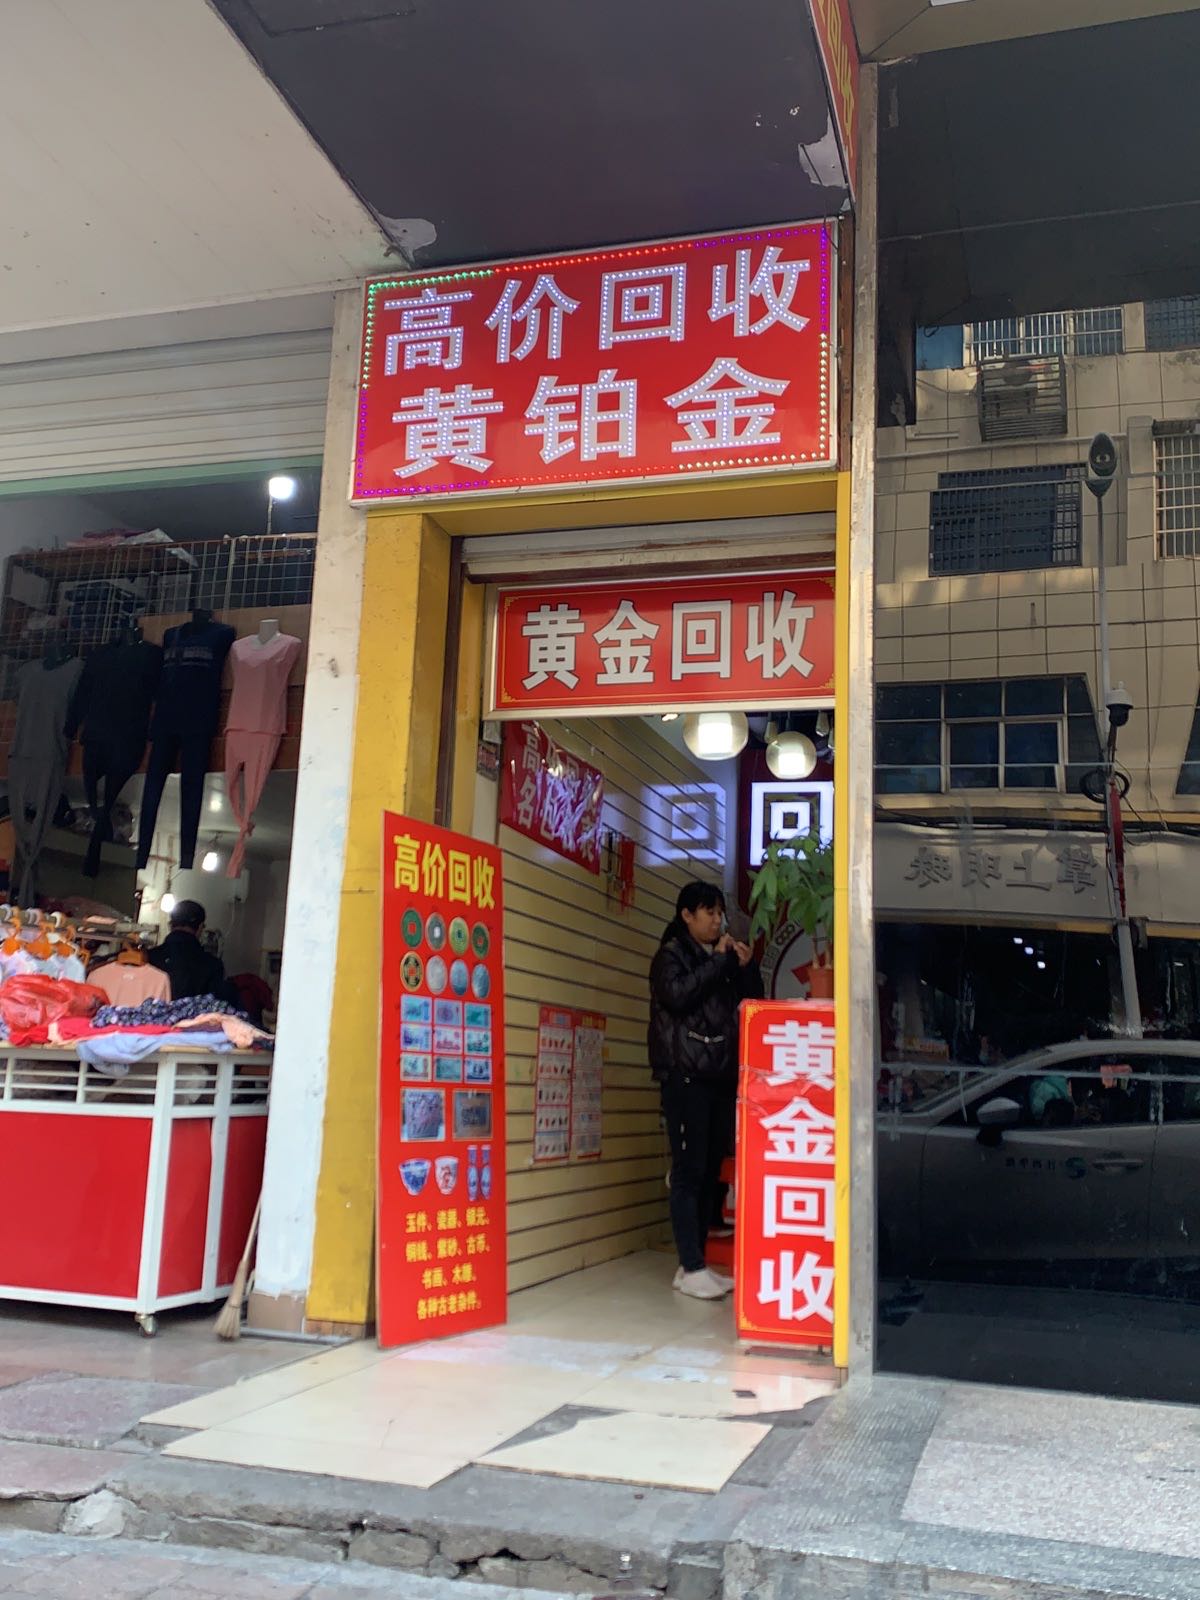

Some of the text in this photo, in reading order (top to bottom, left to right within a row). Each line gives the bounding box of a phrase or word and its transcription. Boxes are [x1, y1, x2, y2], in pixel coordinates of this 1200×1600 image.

[817, 0, 855, 158] 回收
[384, 245, 811, 376] 高价回收
[392, 357, 790, 478] 黄铂金
[521, 589, 816, 691] 黄金回收
[393, 833, 496, 910] 高价回收
[757, 1020, 835, 1324] 黄金回收
